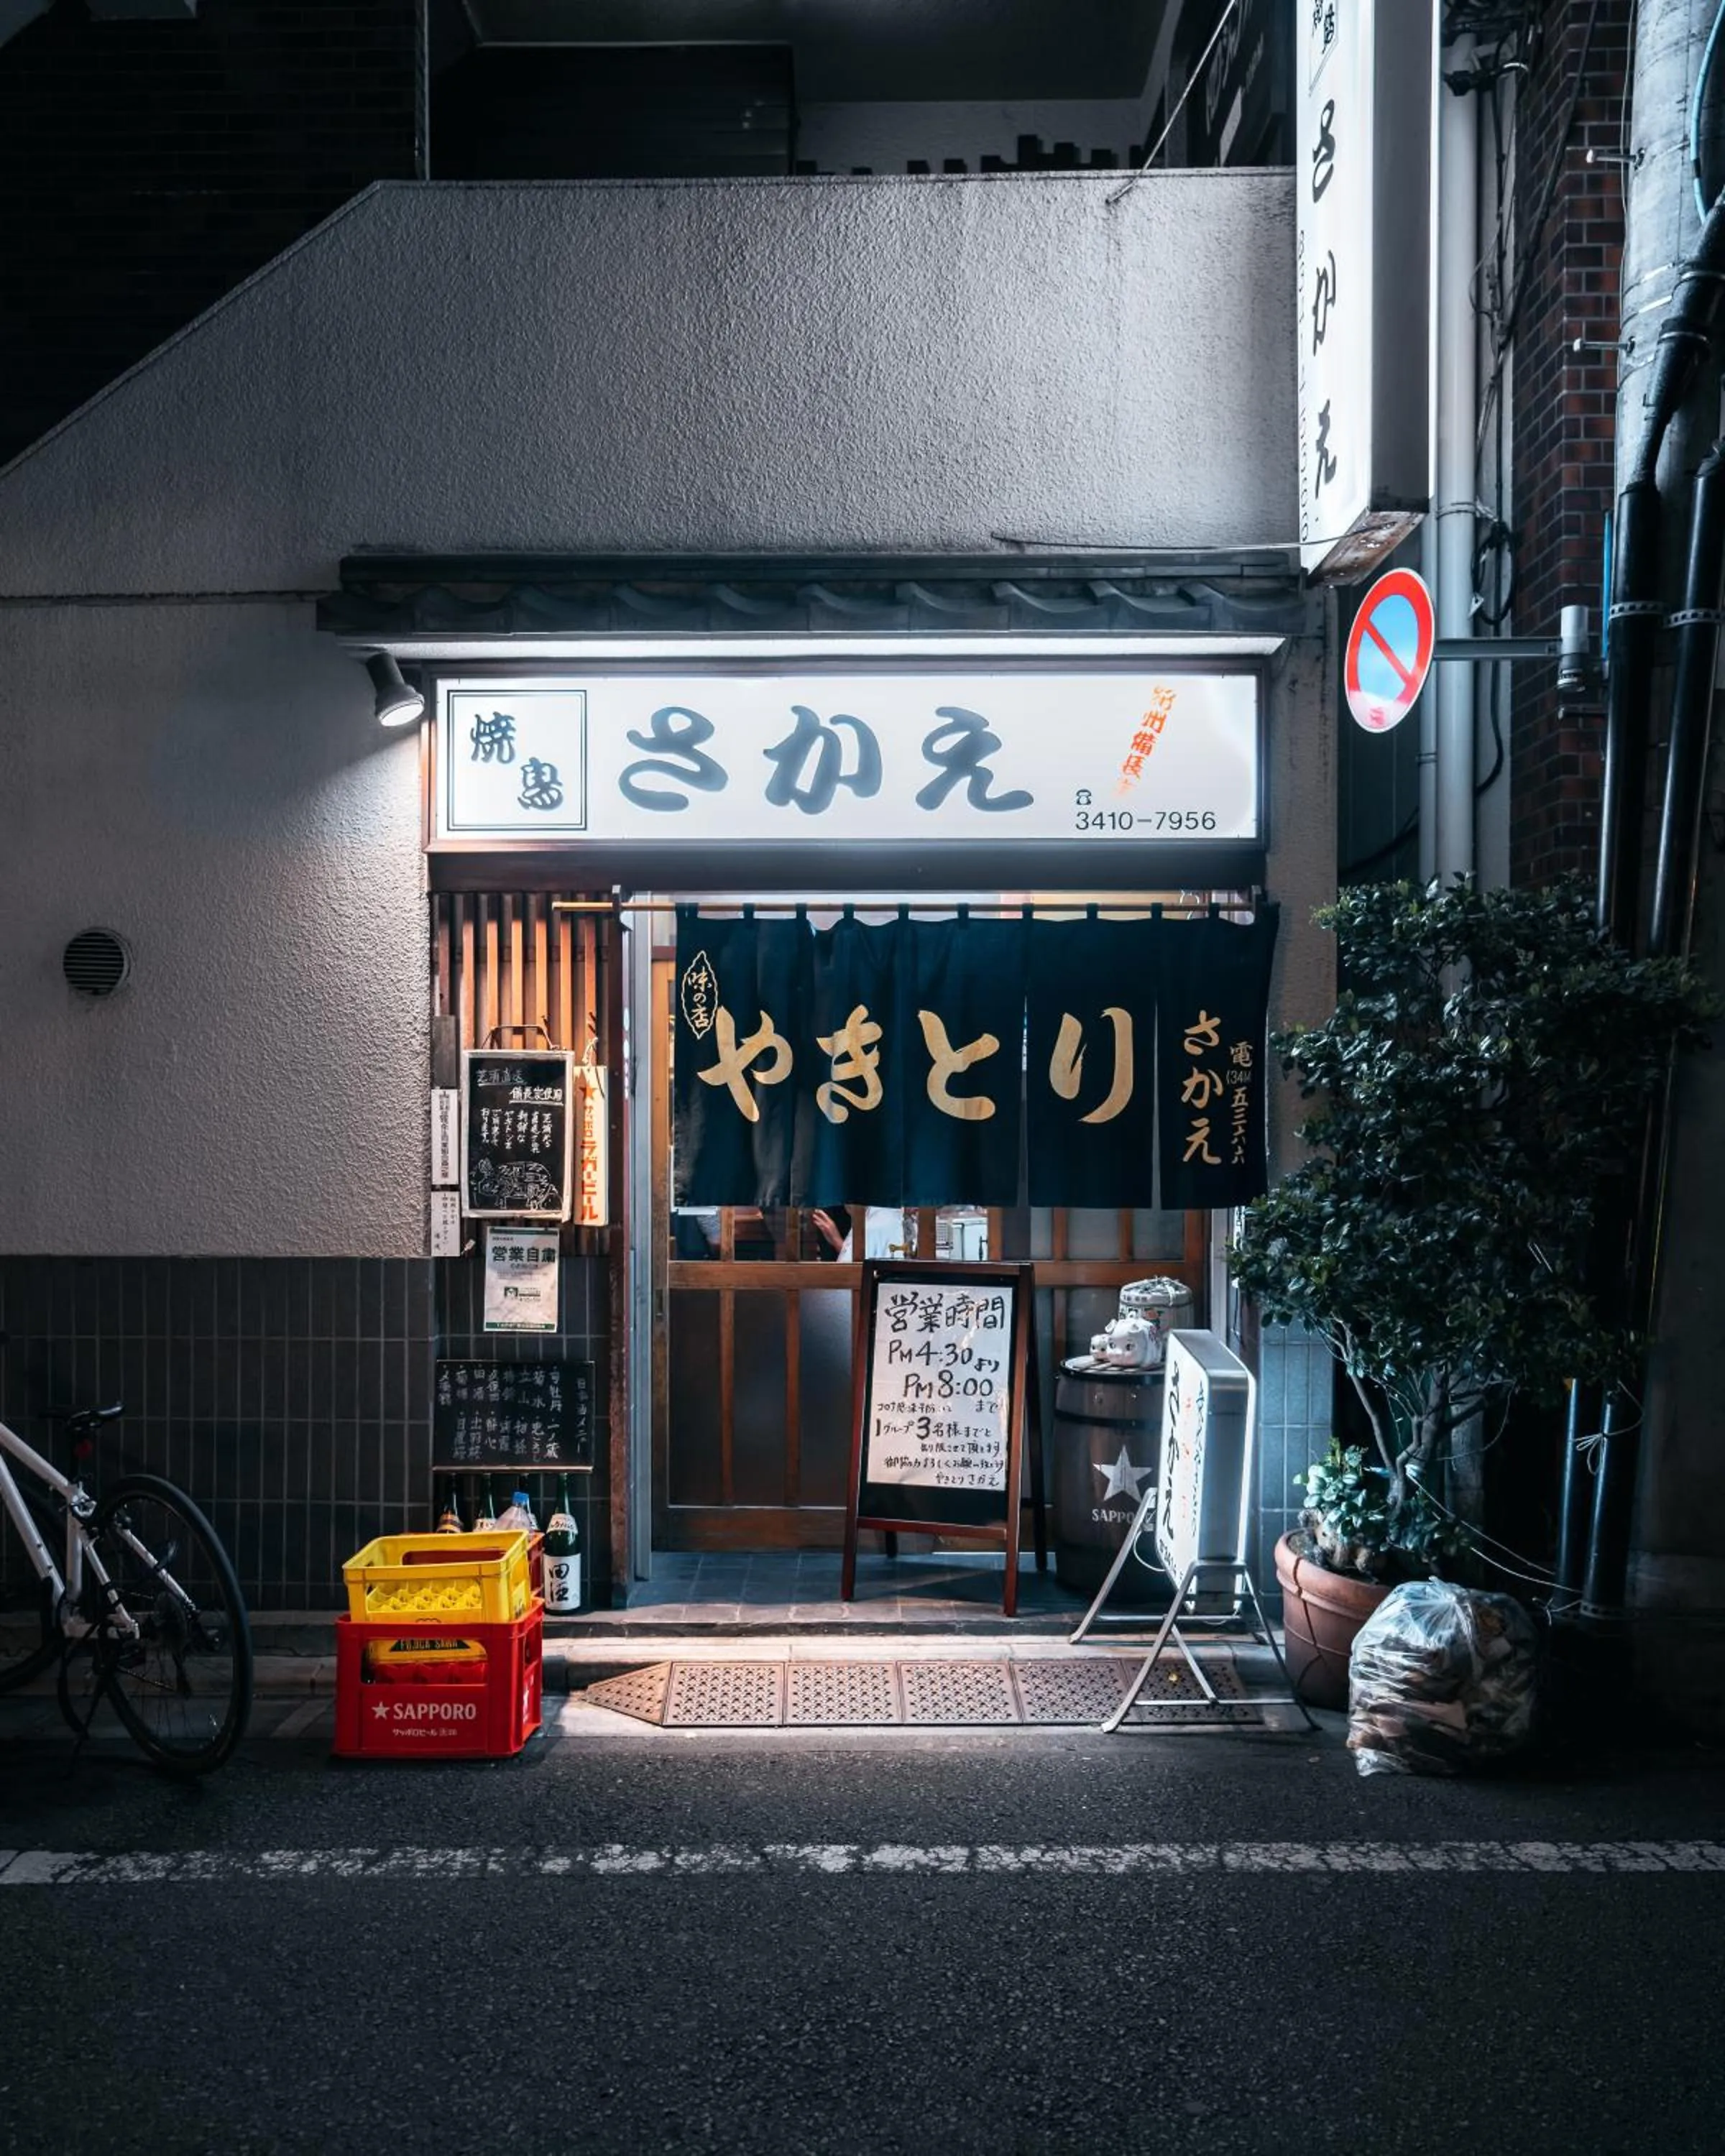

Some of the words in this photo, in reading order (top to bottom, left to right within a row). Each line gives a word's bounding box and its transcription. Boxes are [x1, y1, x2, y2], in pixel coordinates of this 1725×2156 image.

[1312, 98, 1336, 499] さかえ
[469, 710, 565, 812] 焼鳥
[618, 706, 1034, 815] さかえ
[1075, 811, 1216, 831] 3410-7956
[687, 967, 712, 1029] 味の店
[697, 1004, 1133, 1124] やきとり
[1180, 1010, 1223, 1165] さかえ
[492, 1245, 556, 1263] 営業自粛
[884, 1291, 1005, 1332] 営業時間
[975, 1401, 999, 1414] まで
[1092, 1508, 1140, 1524] SAPPO
[393, 1703, 477, 1720] SAPPORO
